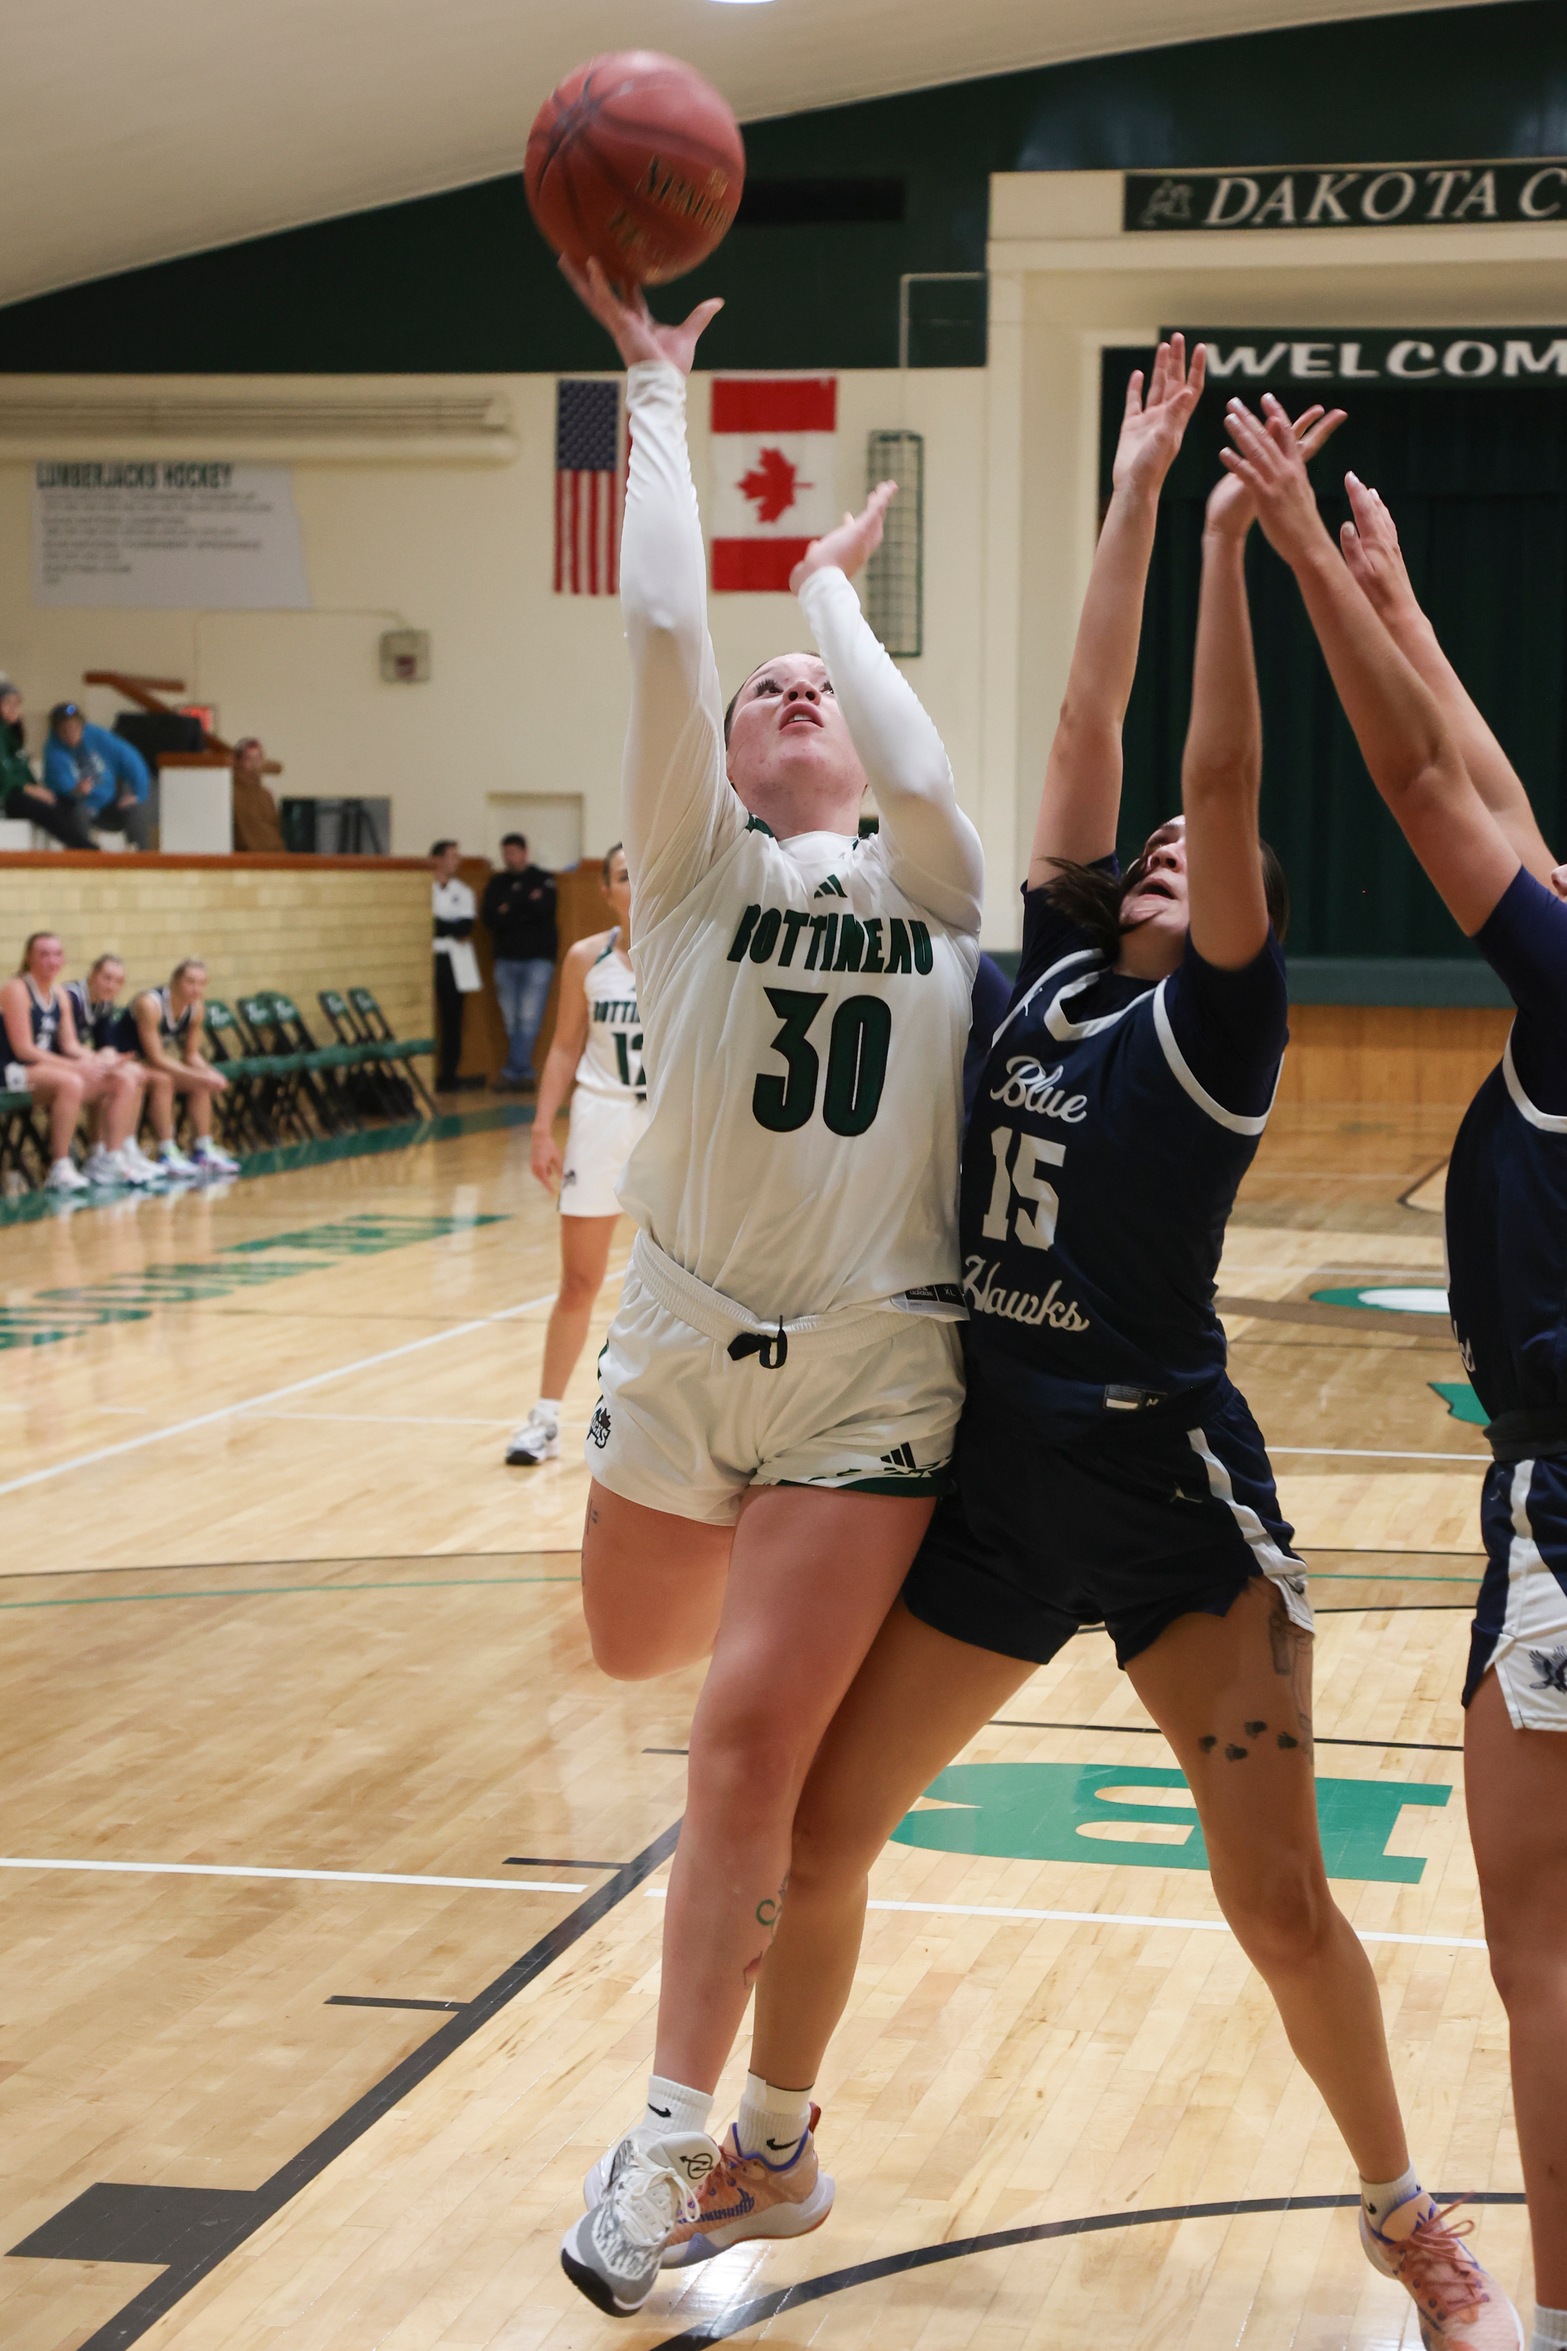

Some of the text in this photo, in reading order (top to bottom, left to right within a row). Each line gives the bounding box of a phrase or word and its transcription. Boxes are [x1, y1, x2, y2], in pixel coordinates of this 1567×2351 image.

[1202, 169, 1498, 226] DAKOTA
[1204, 338, 1567, 379] WELCOM
[163, 461, 235, 489] HOCKEY
[752, 986, 892, 1137] 30
[990, 1055, 1088, 1123] Blue
[982, 1126, 1067, 1251] 15
[964, 1254, 1090, 1332] Hawks
